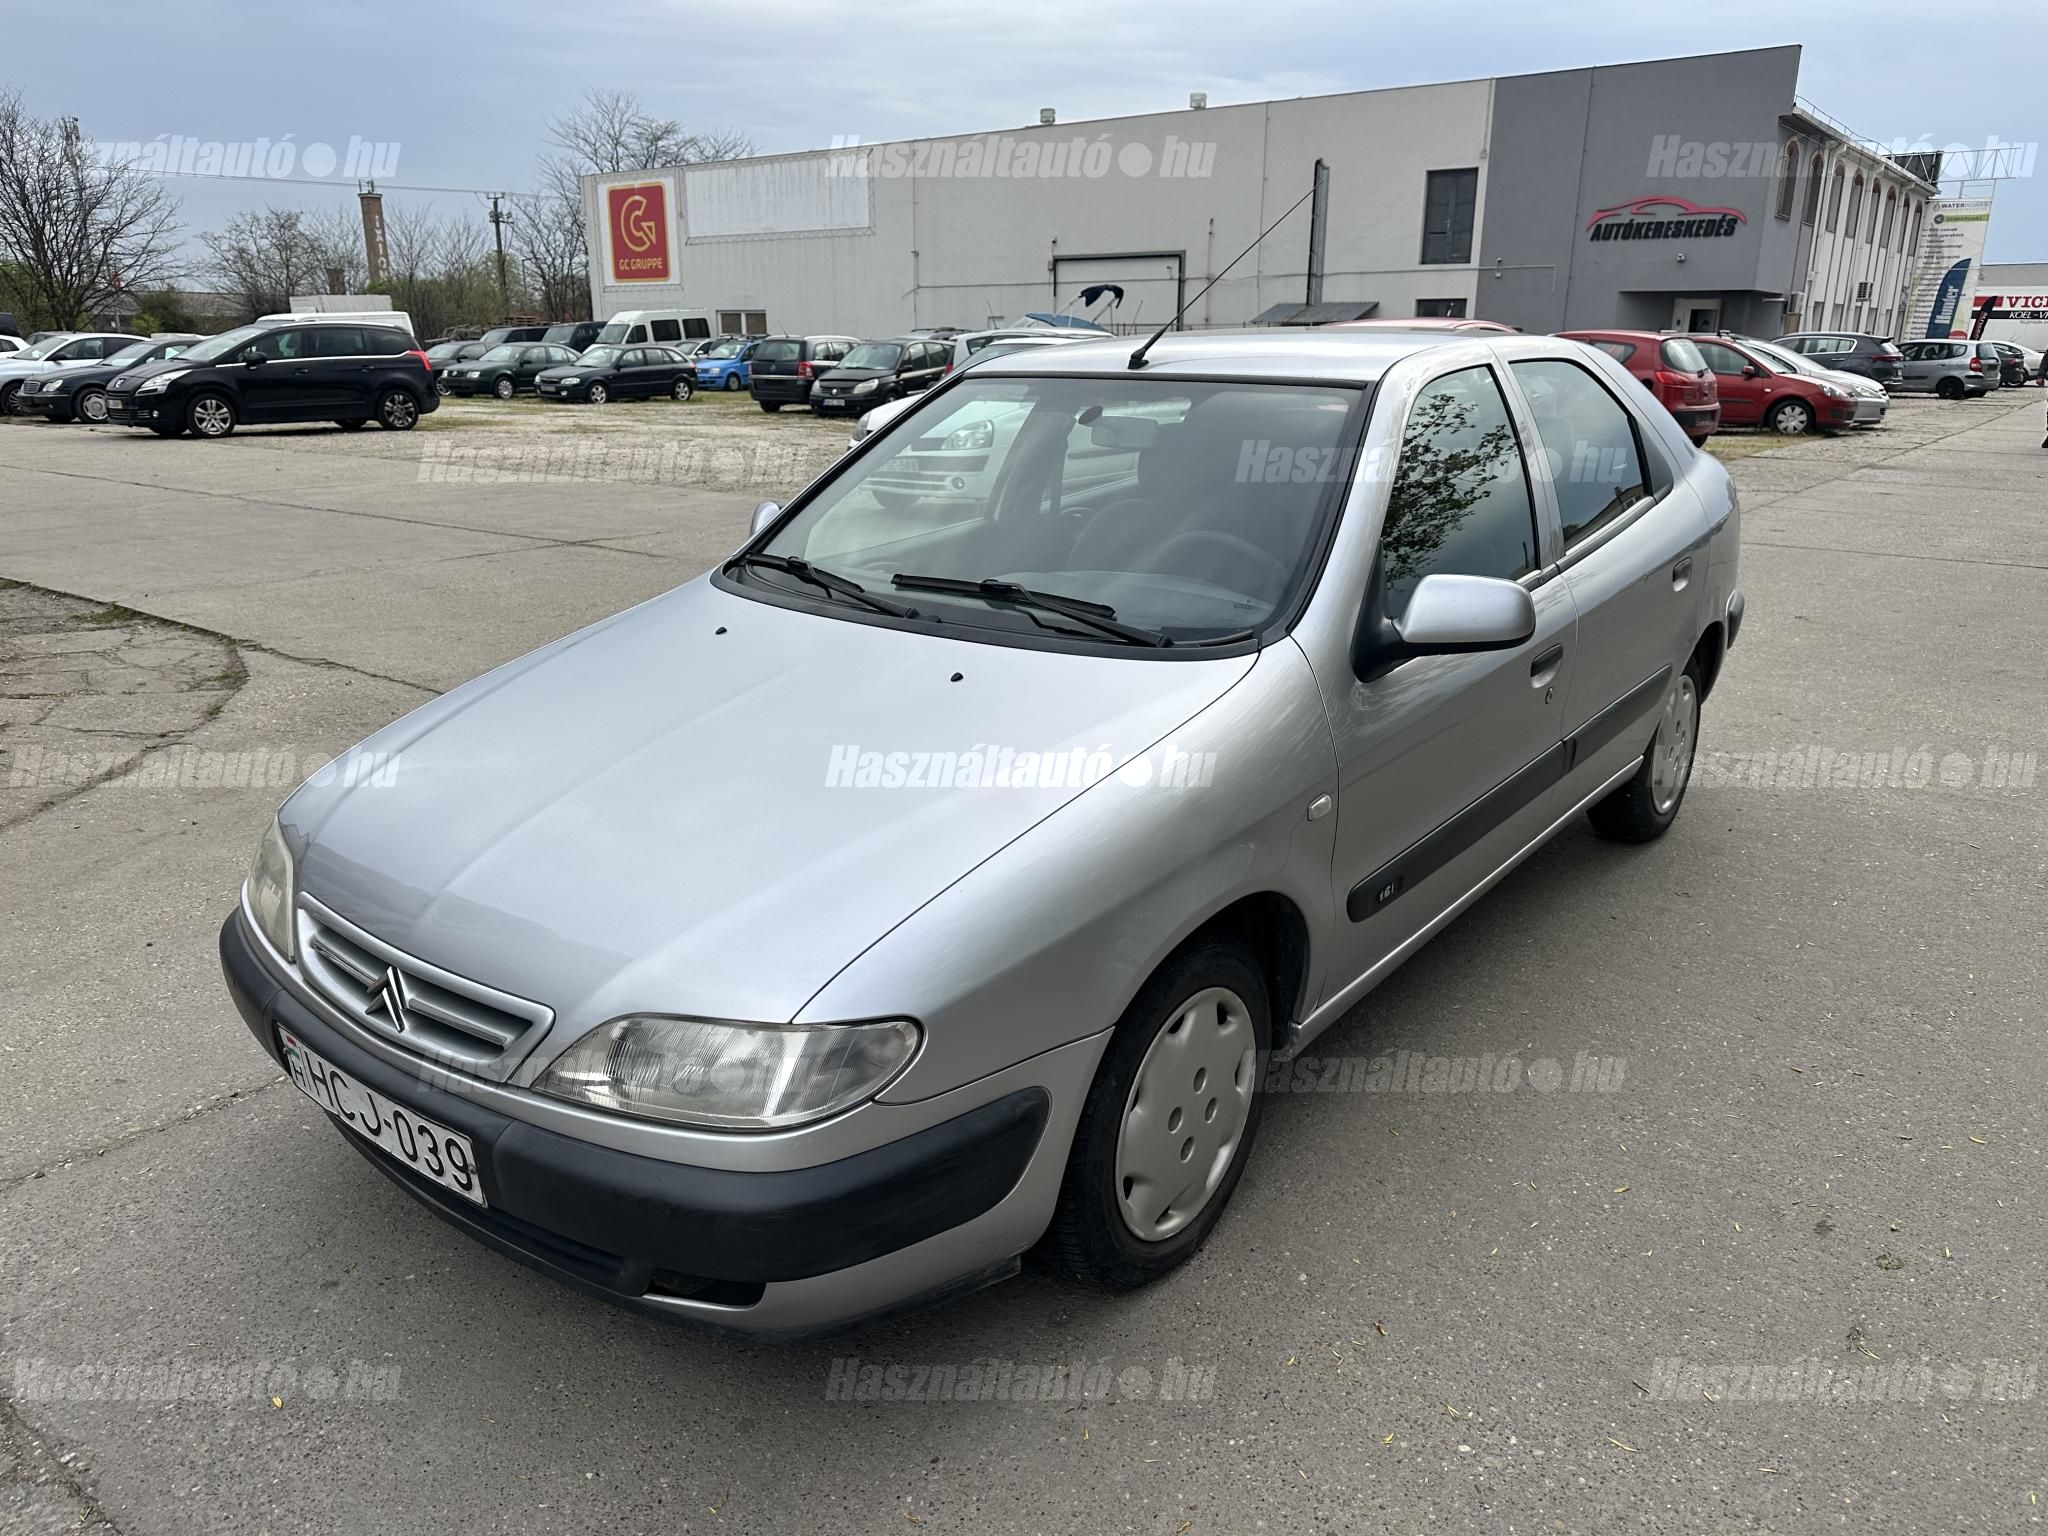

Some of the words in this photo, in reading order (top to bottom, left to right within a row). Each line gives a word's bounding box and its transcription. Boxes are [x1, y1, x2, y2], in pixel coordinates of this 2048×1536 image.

[1590, 214, 1738, 242] AUTÓKERESKEDÉS
[619, 258, 630, 270] GC
[630, 257, 663, 270] GRUPPE
[304, 1051, 473, 1191] HCJ-039
